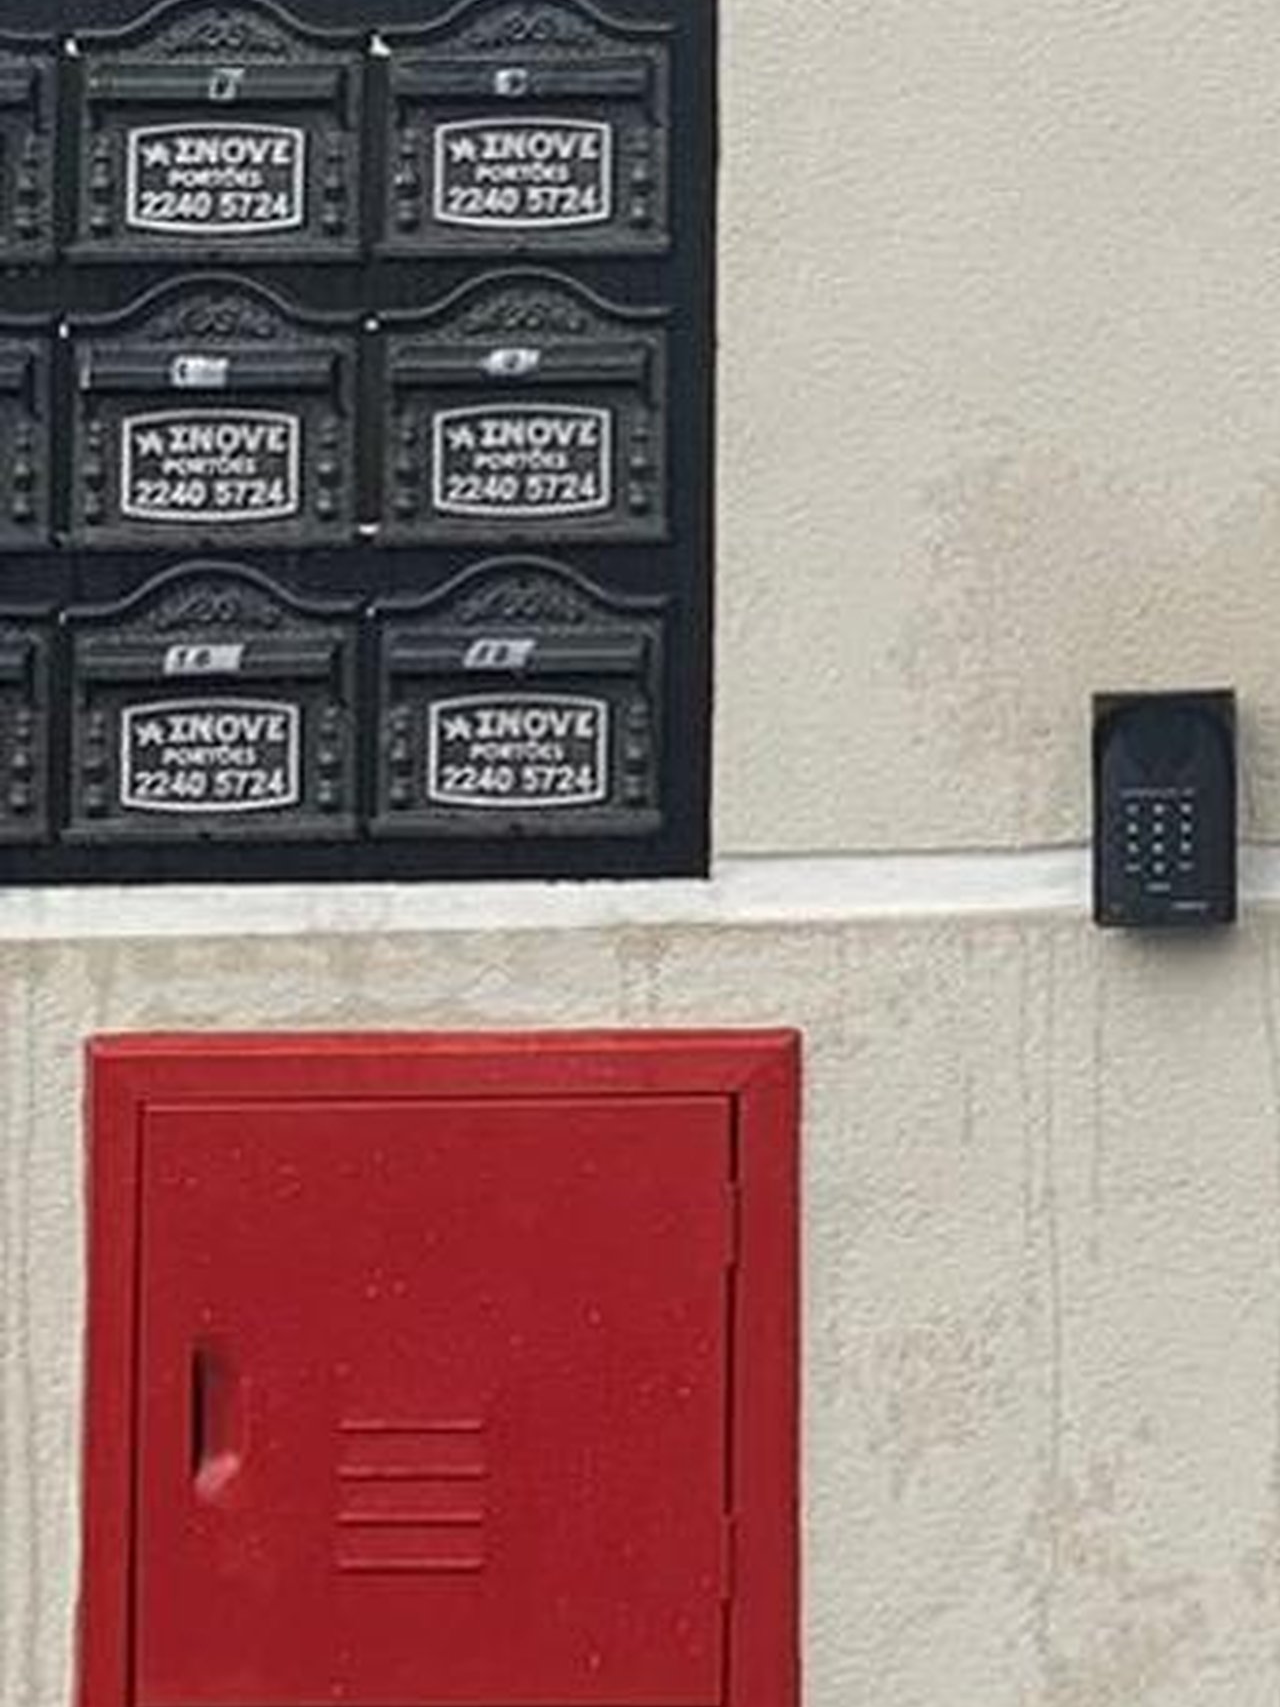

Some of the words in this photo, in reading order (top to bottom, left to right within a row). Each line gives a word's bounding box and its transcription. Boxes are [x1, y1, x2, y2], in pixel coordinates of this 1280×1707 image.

[174, 136, 291, 164] INOVE
[480, 131, 599, 159] INOVE
[139, 190, 212, 219] 2240
[219, 190, 288, 219] 5724
[447, 186, 520, 214] 2240
[526, 185, 596, 214] 5724
[168, 424, 286, 453] INOVE
[478, 417, 599, 447] INOVE
[134, 478, 207, 507] 2240
[213, 477, 286, 507] 5724
[446, 473, 519, 502] 2240
[525, 471, 596, 502] 5724
[167, 713, 286, 743] INOVE
[474, 709, 595, 738] INOVE
[134, 768, 207, 798] 2240
[213, 768, 285, 798] 5724
[442, 763, 514, 793] 2240
[521, 763, 595, 795] 5724
